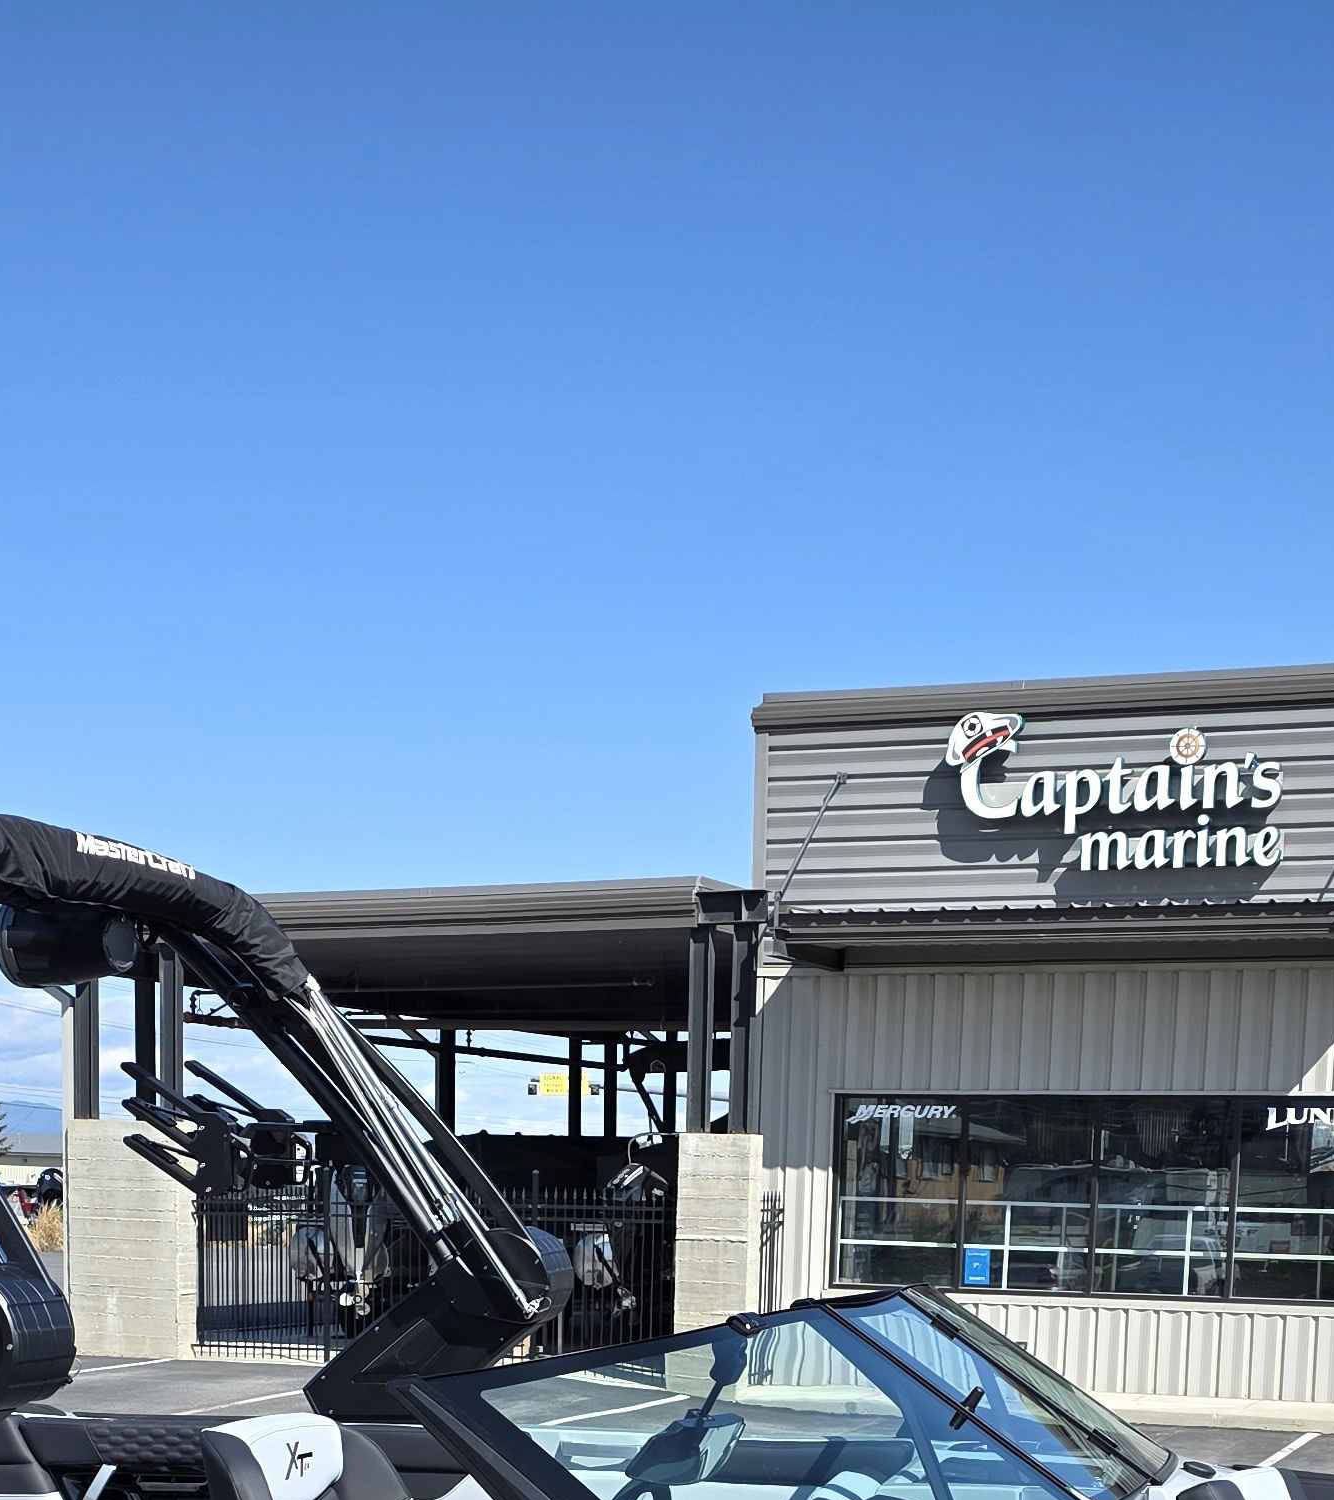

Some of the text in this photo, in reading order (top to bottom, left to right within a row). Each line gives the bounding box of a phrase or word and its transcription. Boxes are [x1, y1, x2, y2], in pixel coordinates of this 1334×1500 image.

[948, 720, 1283, 833] Captain's
[76, 832, 196, 880] MasterCraft
[1080, 814, 1283, 871] marine
[847, 1104, 957, 1123] MERCURY
